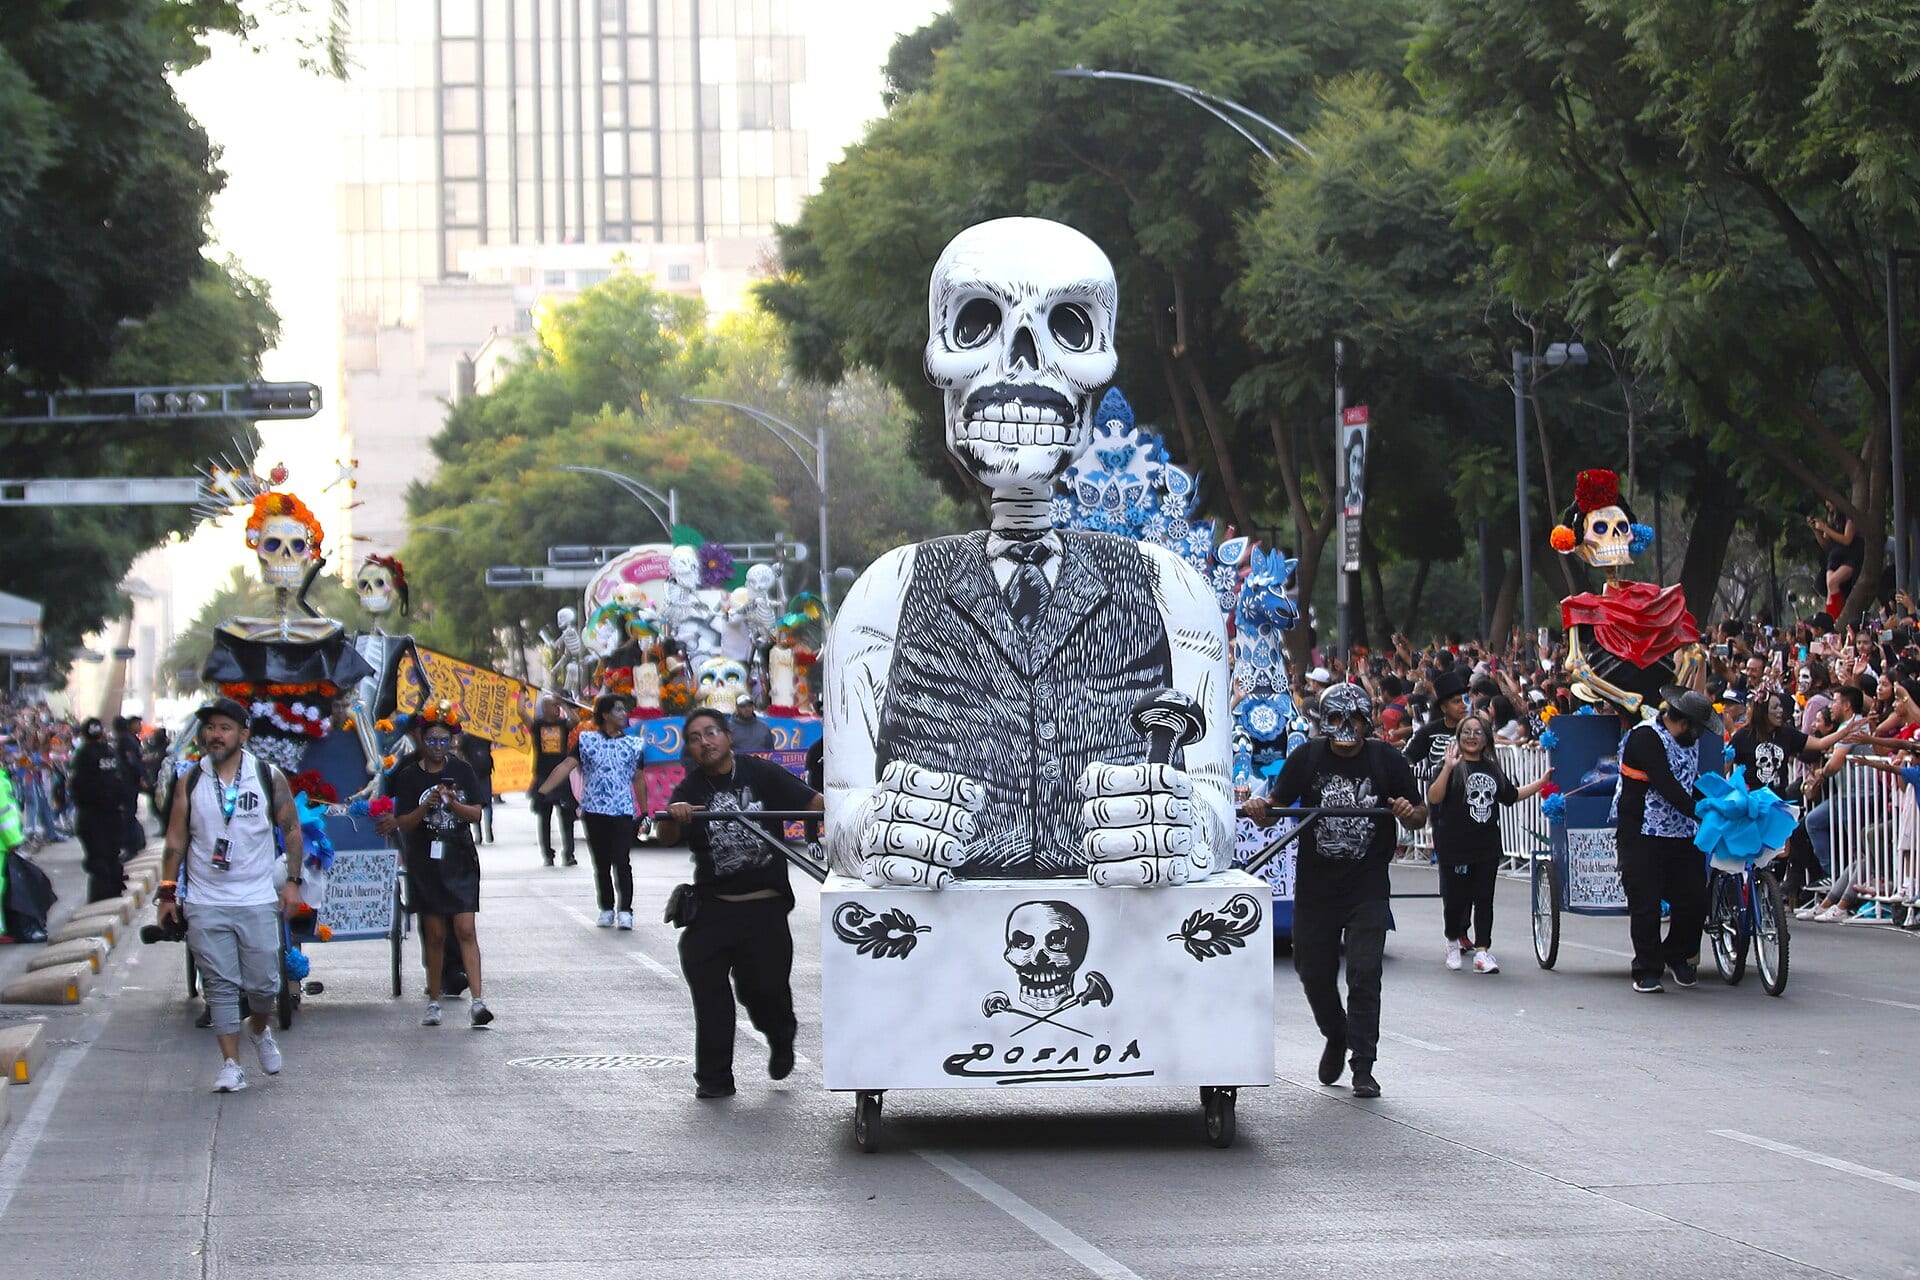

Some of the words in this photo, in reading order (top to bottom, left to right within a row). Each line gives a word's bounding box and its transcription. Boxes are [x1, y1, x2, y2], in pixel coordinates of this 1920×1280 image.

[477, 683, 489, 721] DESFILE
[491, 684, 507, 731] MUERTOS
[354, 884, 381, 897] Muertos
[943, 1039, 1142, 1077] POSADA
